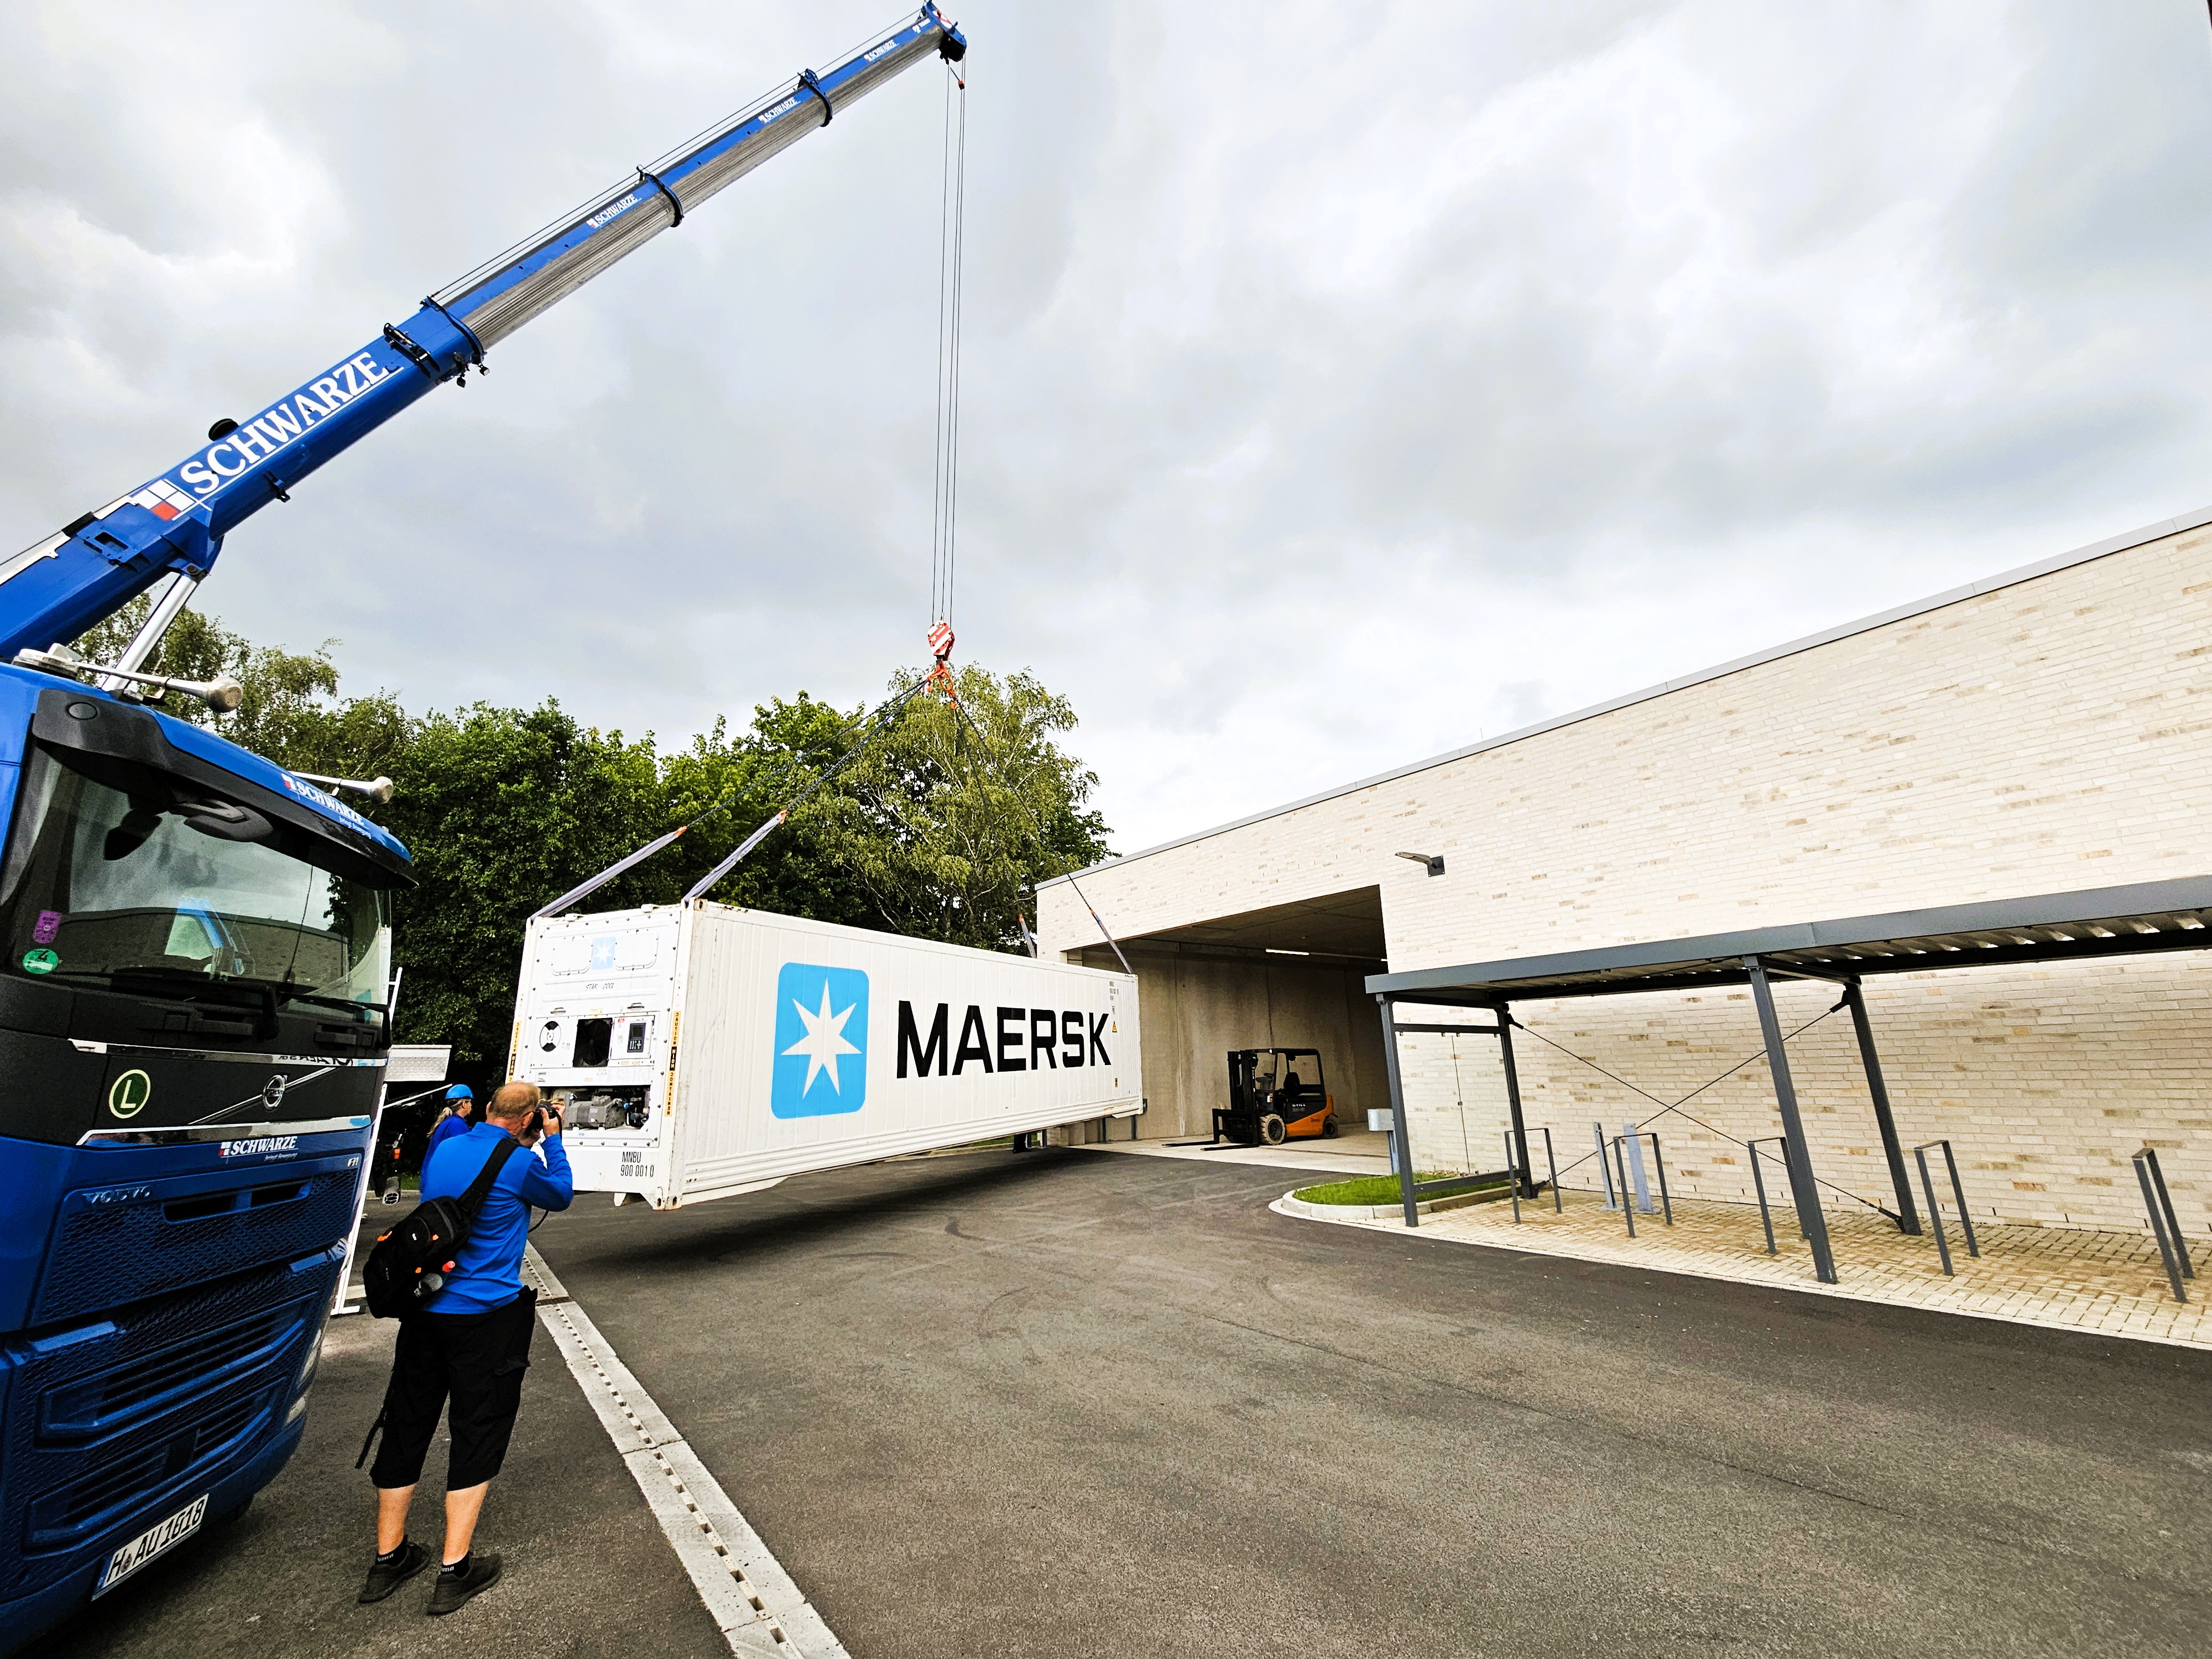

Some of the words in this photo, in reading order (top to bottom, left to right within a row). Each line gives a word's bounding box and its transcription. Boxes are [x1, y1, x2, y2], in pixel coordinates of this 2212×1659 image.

[764, 96, 798, 120] SCHWARZE
[594, 194, 638, 225] SCHWARZE
[180, 352, 389, 494] SCHWARZE
[296, 781, 365, 826] SCHWARZE
[896, 1000, 1112, 1079] MAERSK
[121, 1079, 137, 1108] L
[230, 1135, 298, 1156] SCHWARZE
[622, 1151, 641, 1163] MNBU
[347, 1156, 359, 1167] FH
[620, 1164, 633, 1177] 900
[82, 1185, 152, 1204] VOLVO
